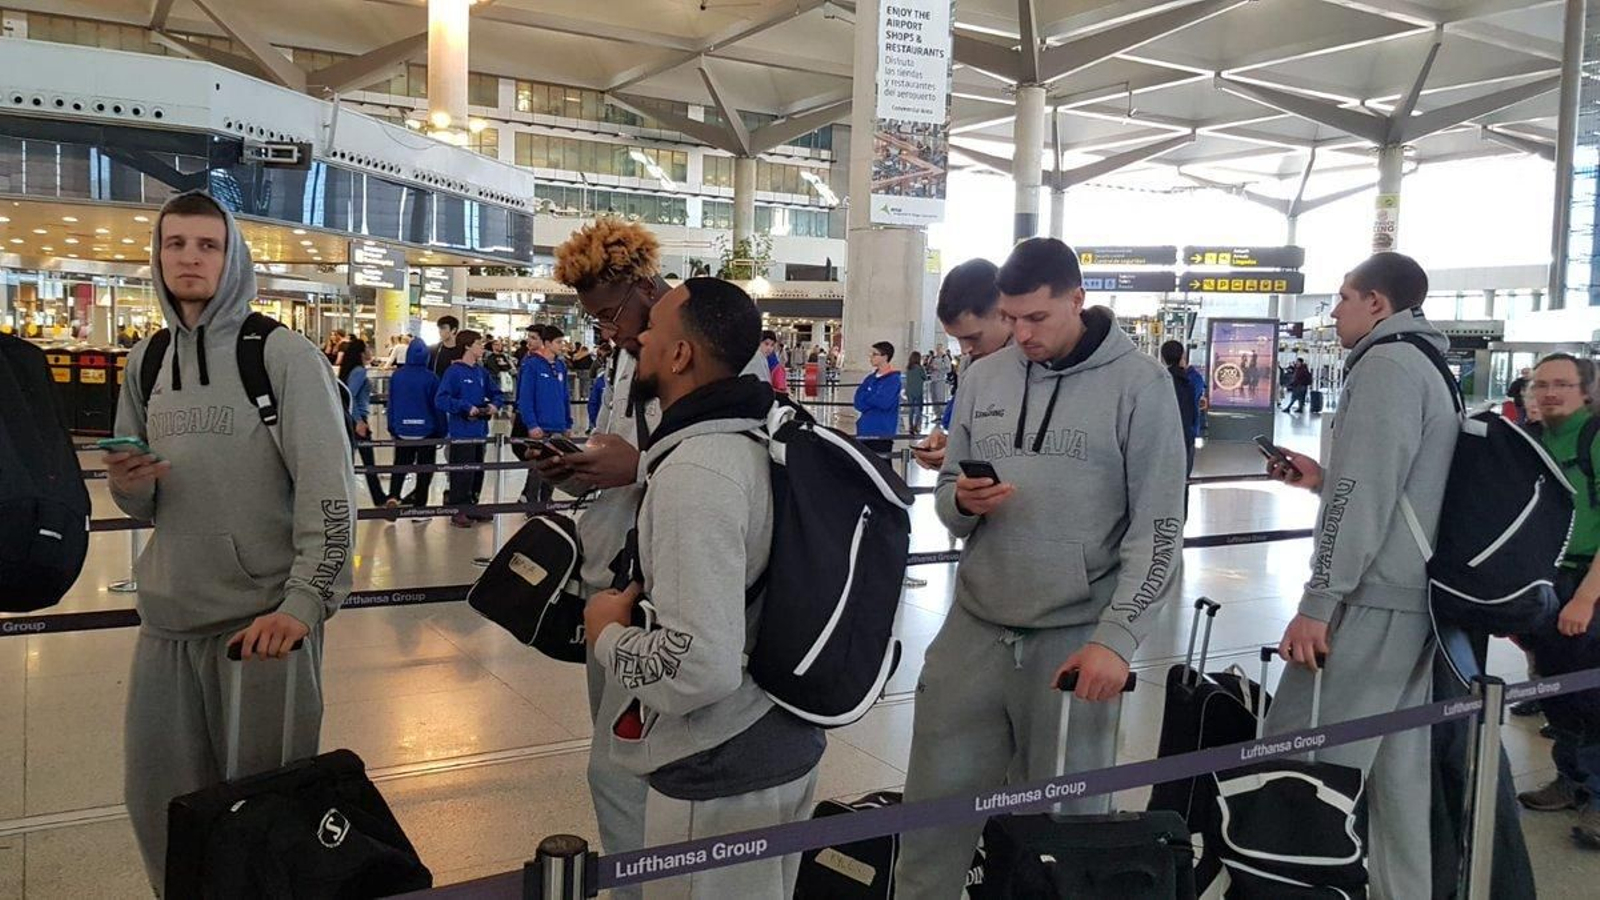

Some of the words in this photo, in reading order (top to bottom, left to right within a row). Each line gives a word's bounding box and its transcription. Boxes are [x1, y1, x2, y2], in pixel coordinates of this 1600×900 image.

[886, 6, 912, 18] ENJOY
[914, 9, 931, 20] THE
[886, 18, 923, 31] AIRPORT
[885, 30, 914, 42] SHOPS
[885, 43, 945, 58] RESTAURANTS
[147, 405, 235, 440] NICAJA
[308, 500, 350, 601] ALDING
[392, 592, 426, 602] Group
[2, 620, 47, 633] Group
[1537, 682, 1561, 694] Group
[1240, 741, 1292, 760] Lufthansa
[1293, 734, 1326, 749] Group
[975, 789, 1042, 811] Lufthansa
[1045, 781, 1087, 798] Group
[615, 849, 707, 878] Lufthansa
[712, 838, 768, 860] Group
